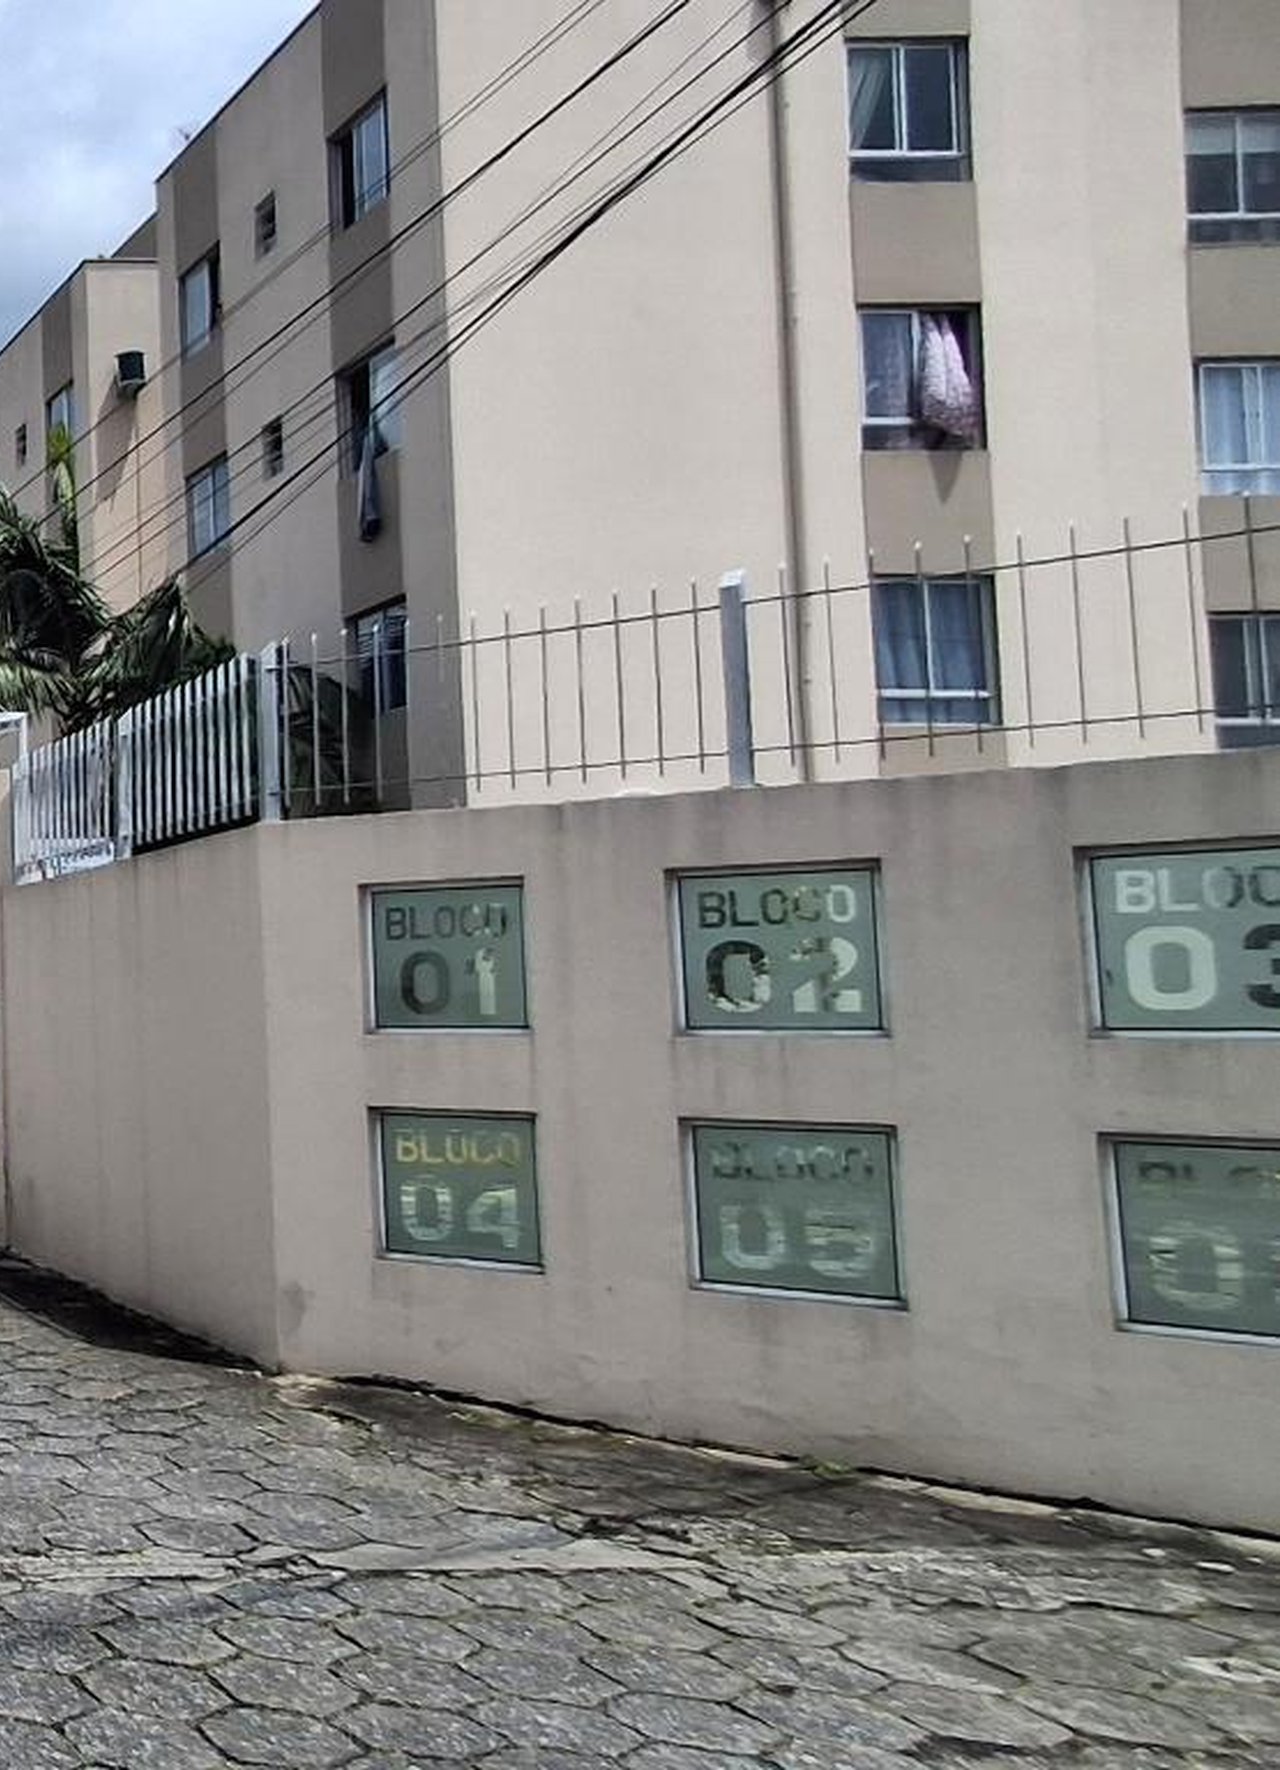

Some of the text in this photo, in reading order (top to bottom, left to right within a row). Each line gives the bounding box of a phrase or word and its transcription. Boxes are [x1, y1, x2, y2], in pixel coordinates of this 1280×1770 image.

[386, 902, 507, 940] BLOCO
[697, 884, 856, 928] BLOCO
[400, 948, 497, 1015] 01
[706, 937, 862, 1013] 02
[394, 1129, 520, 1168] BLOCO
[400, 1174, 520, 1248] 04
[720, 1203, 875, 1278] 05
